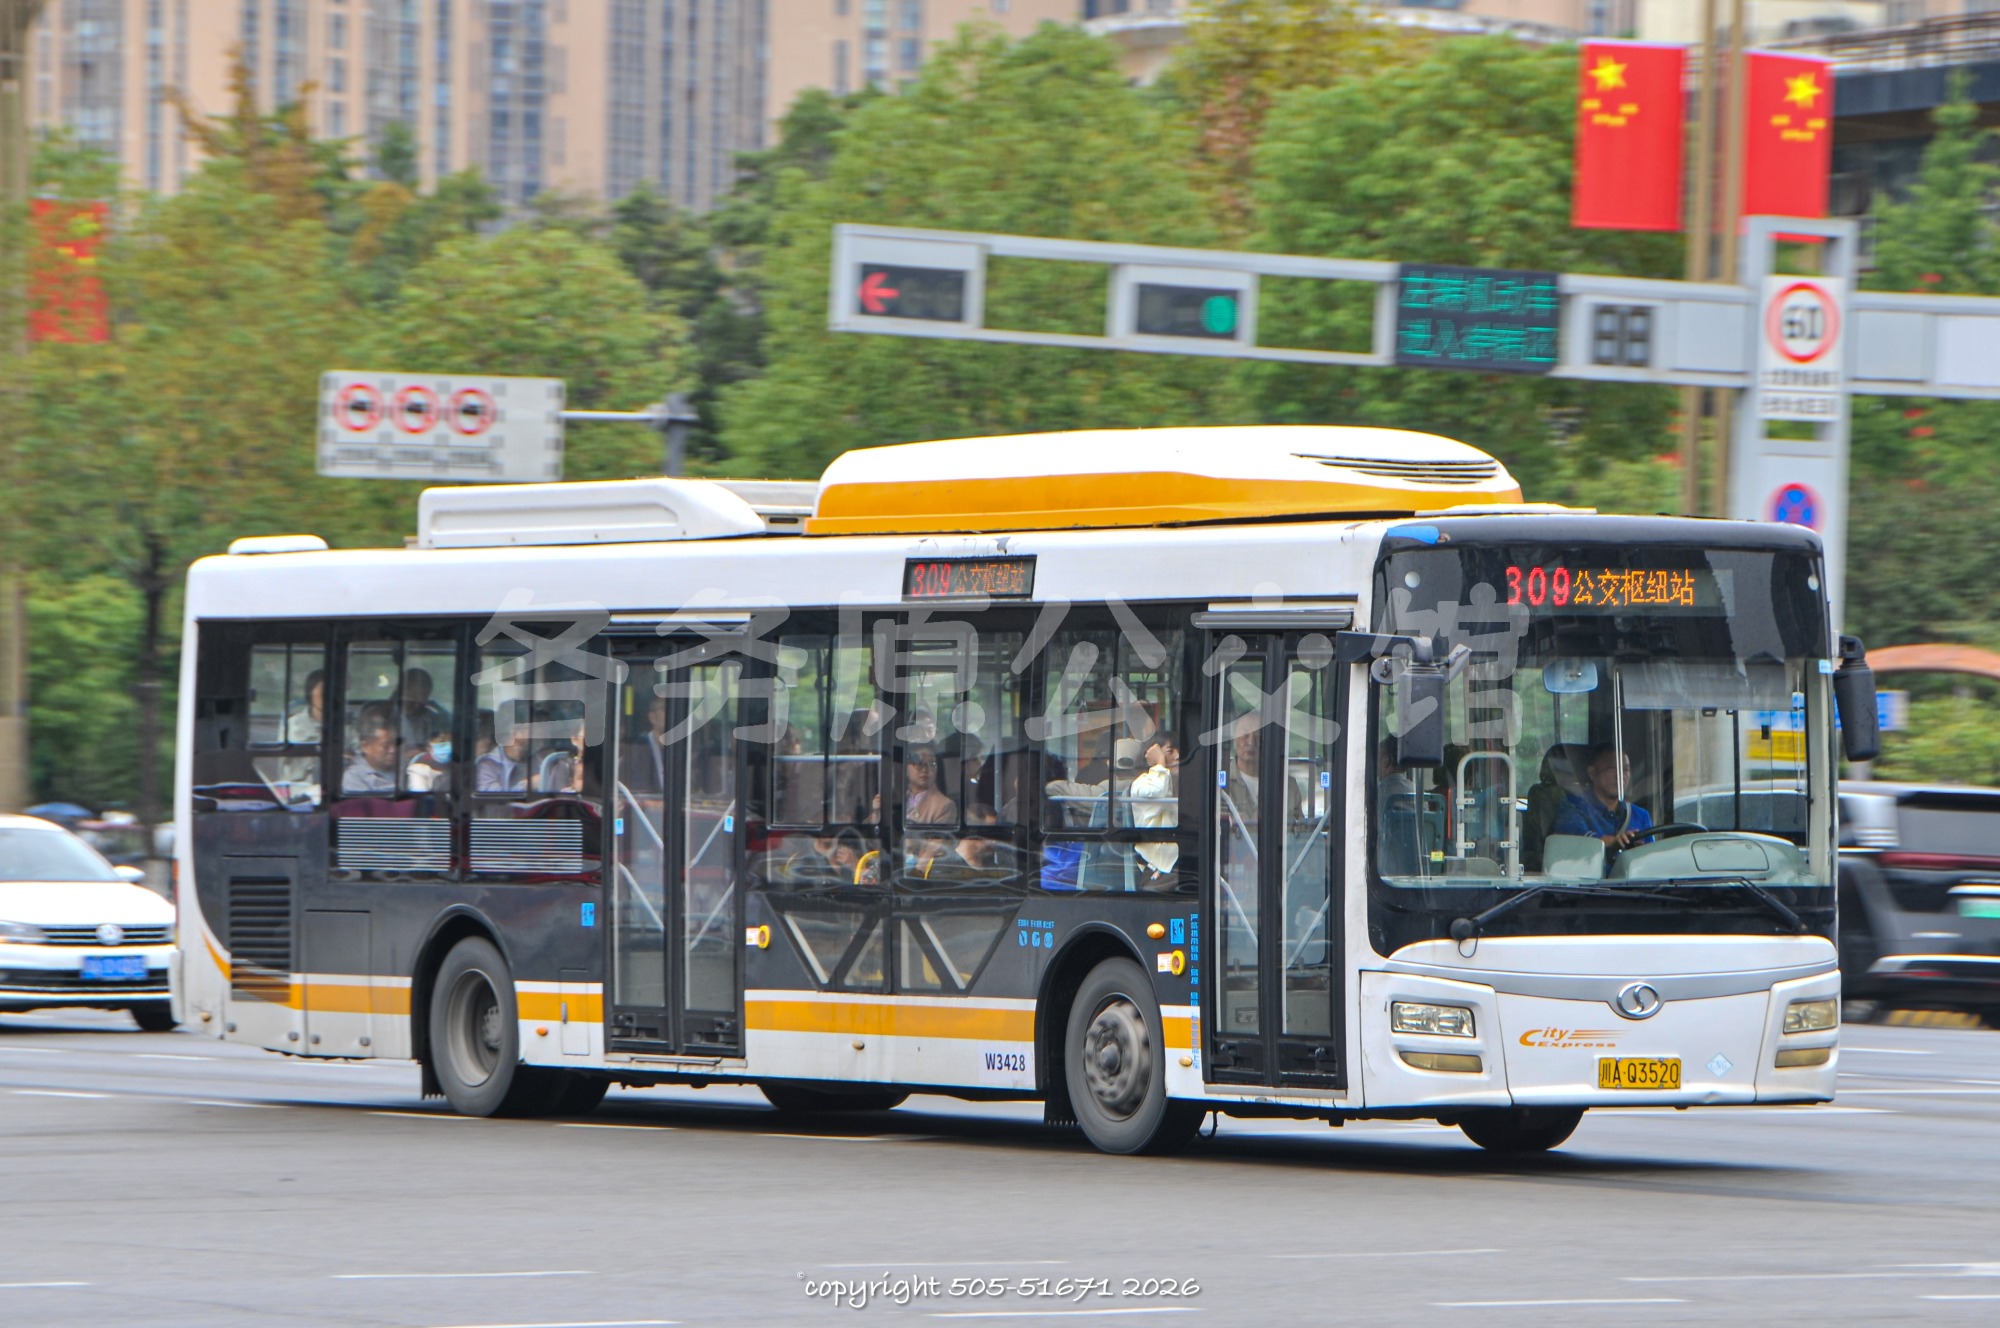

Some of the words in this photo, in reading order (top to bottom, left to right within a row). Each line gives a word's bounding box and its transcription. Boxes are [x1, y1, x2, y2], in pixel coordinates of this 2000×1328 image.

[911, 562, 952, 597] 309
[1505, 565, 1571, 607] 309
[1573, 567, 1696, 607] 公交枢纽站
[1518, 1026, 1570, 1048] City
[985, 1052, 1026, 1072] W3428
